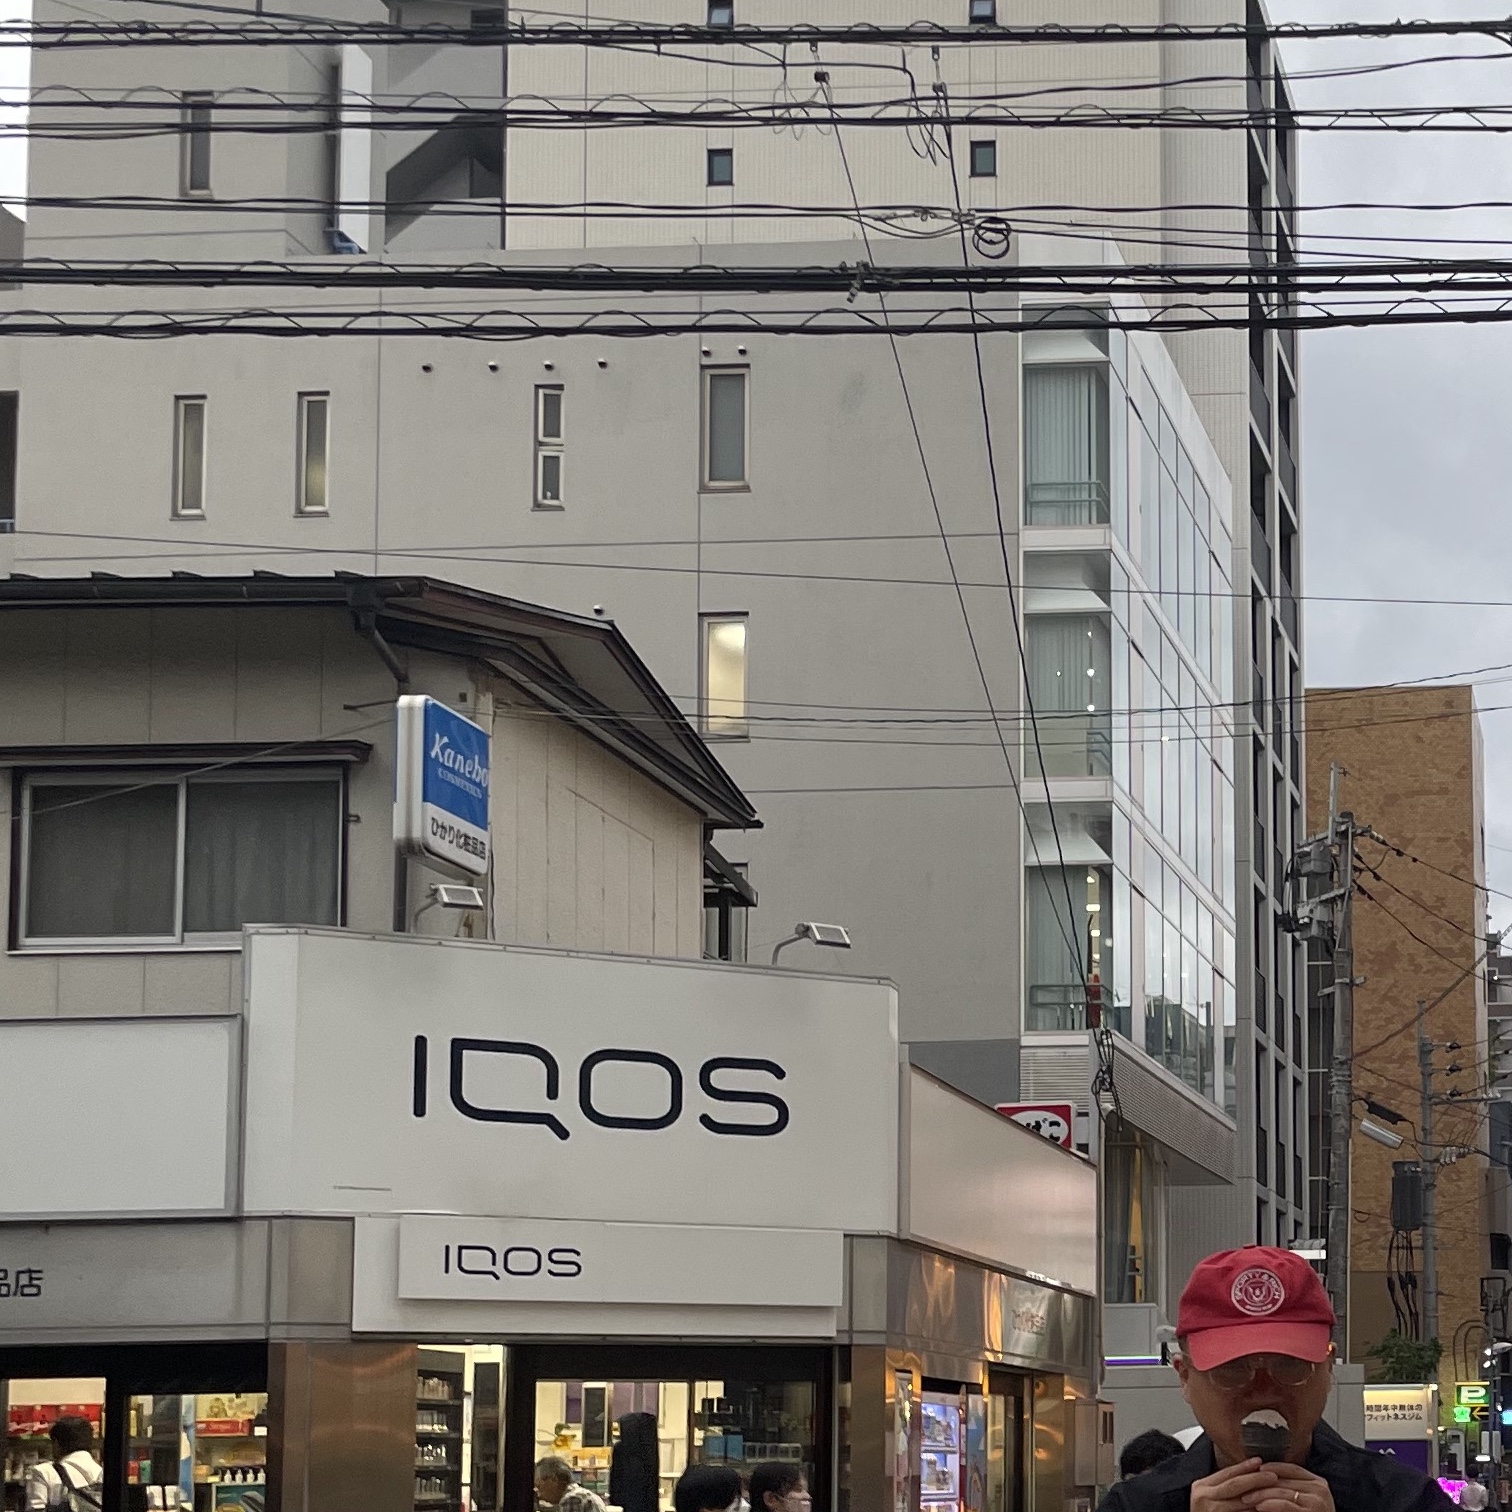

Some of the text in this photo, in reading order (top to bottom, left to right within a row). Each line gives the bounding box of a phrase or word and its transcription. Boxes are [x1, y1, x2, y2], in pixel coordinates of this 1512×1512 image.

[430, 732, 489, 787] Kanebo
[413, 1034, 790, 1141] IQOS
[444, 1244, 582, 1281] IQOS
[1461, 1386, 1486, 1404] P
